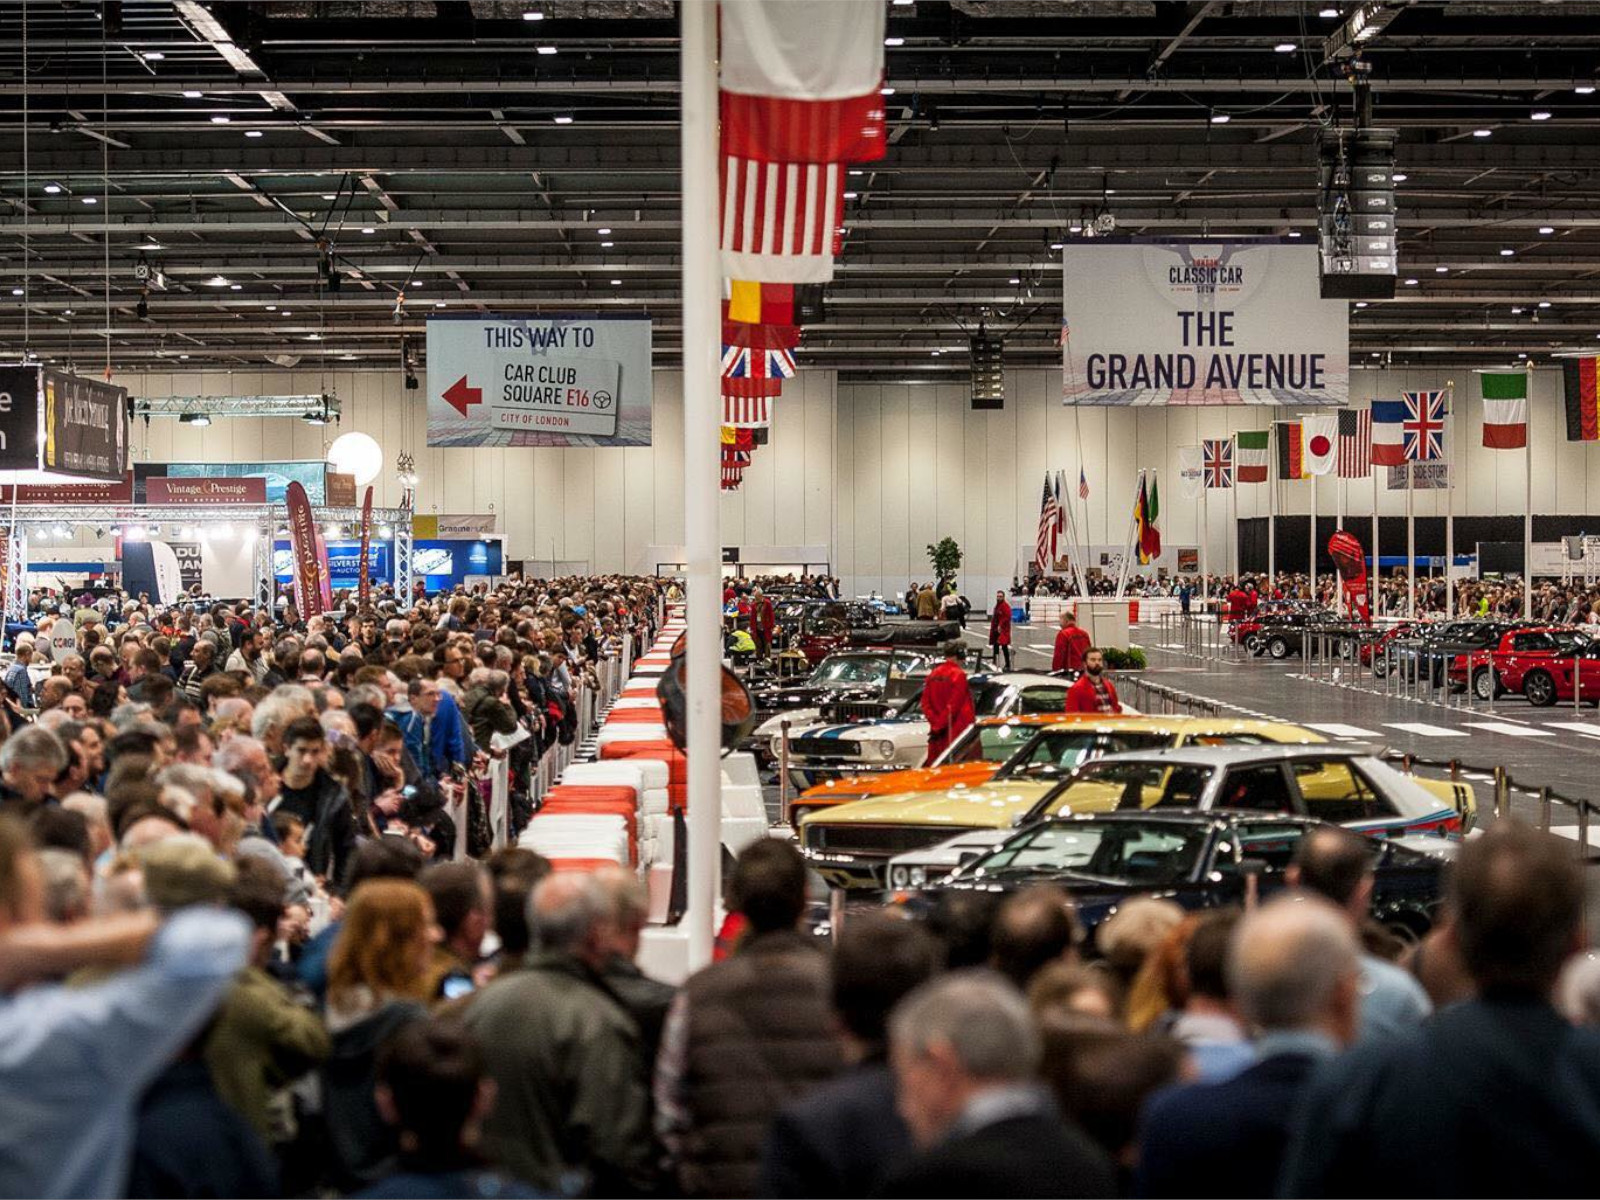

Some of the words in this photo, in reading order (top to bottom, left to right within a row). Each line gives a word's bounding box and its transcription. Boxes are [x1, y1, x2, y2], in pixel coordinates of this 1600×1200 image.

[1169, 267, 1217, 284] CLASSIC
[1220, 267, 1243, 284] CAR
[484, 327, 523, 348] THIS
[528, 327, 568, 348] WAY
[573, 327, 594, 348] TO
[1177, 311, 1235, 347] THE
[504, 363, 534, 383] CAR
[539, 366, 577, 385] CLUB
[1086, 353, 1196, 390] GRAND
[1205, 353, 1326, 390] AVENUE
[503, 385, 562, 404] SQUARE
[566, 389, 589, 407] E16
[500, 413, 519, 423] CITY
[522, 414, 533, 424] OF
[535, 415, 569, 427] LONDON
[1393, 466, 1405, 480] THE
[1406, 465, 1427, 480] ISIDE
[1428, 464, 1448, 479] STORY
[166, 482, 201, 495] Vintage
[210, 482, 247, 495] Prestige
